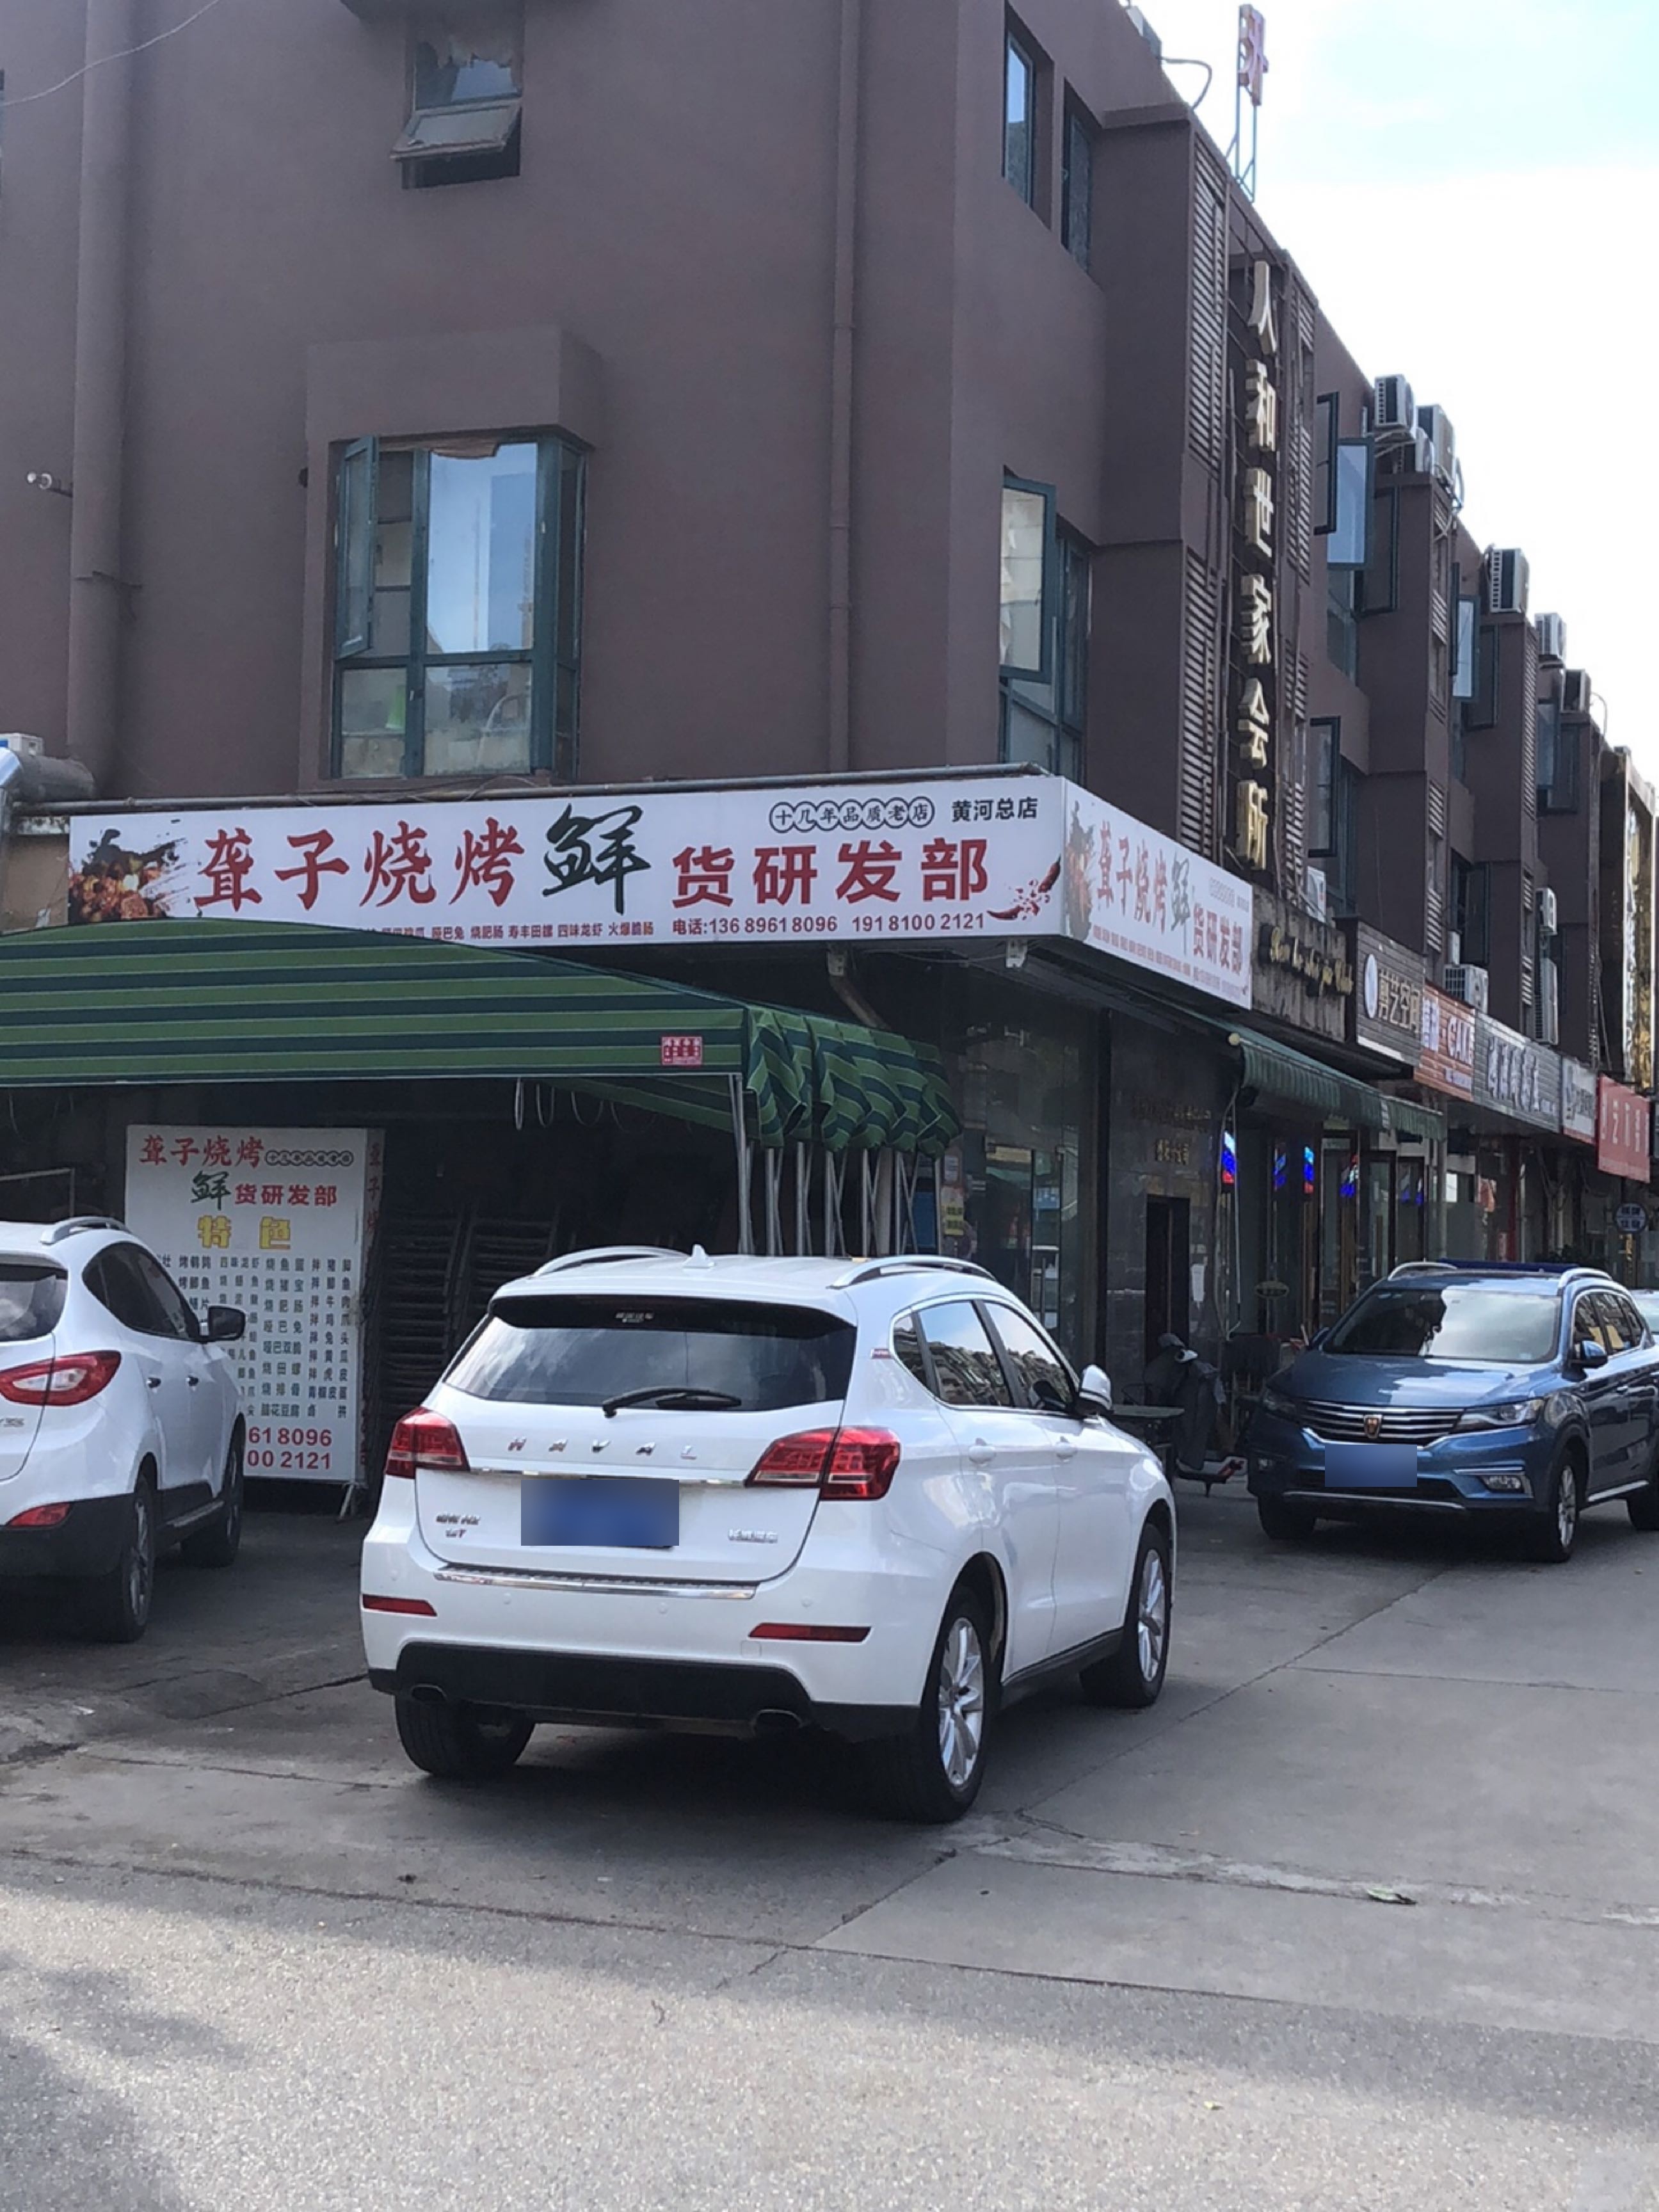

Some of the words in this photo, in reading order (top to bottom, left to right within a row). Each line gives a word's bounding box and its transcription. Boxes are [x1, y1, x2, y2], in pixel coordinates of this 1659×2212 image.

[773, 799, 931, 829] 十几年品质老店
[952, 797, 1038, 822] 黄河总店
[194, 817, 525, 912] 聋子烧烤
[139, 1134, 265, 1168] 聋子烧烤
[197, 1215, 291, 1250] 特色
[507, 1435, 697, 1461] HAVAL
